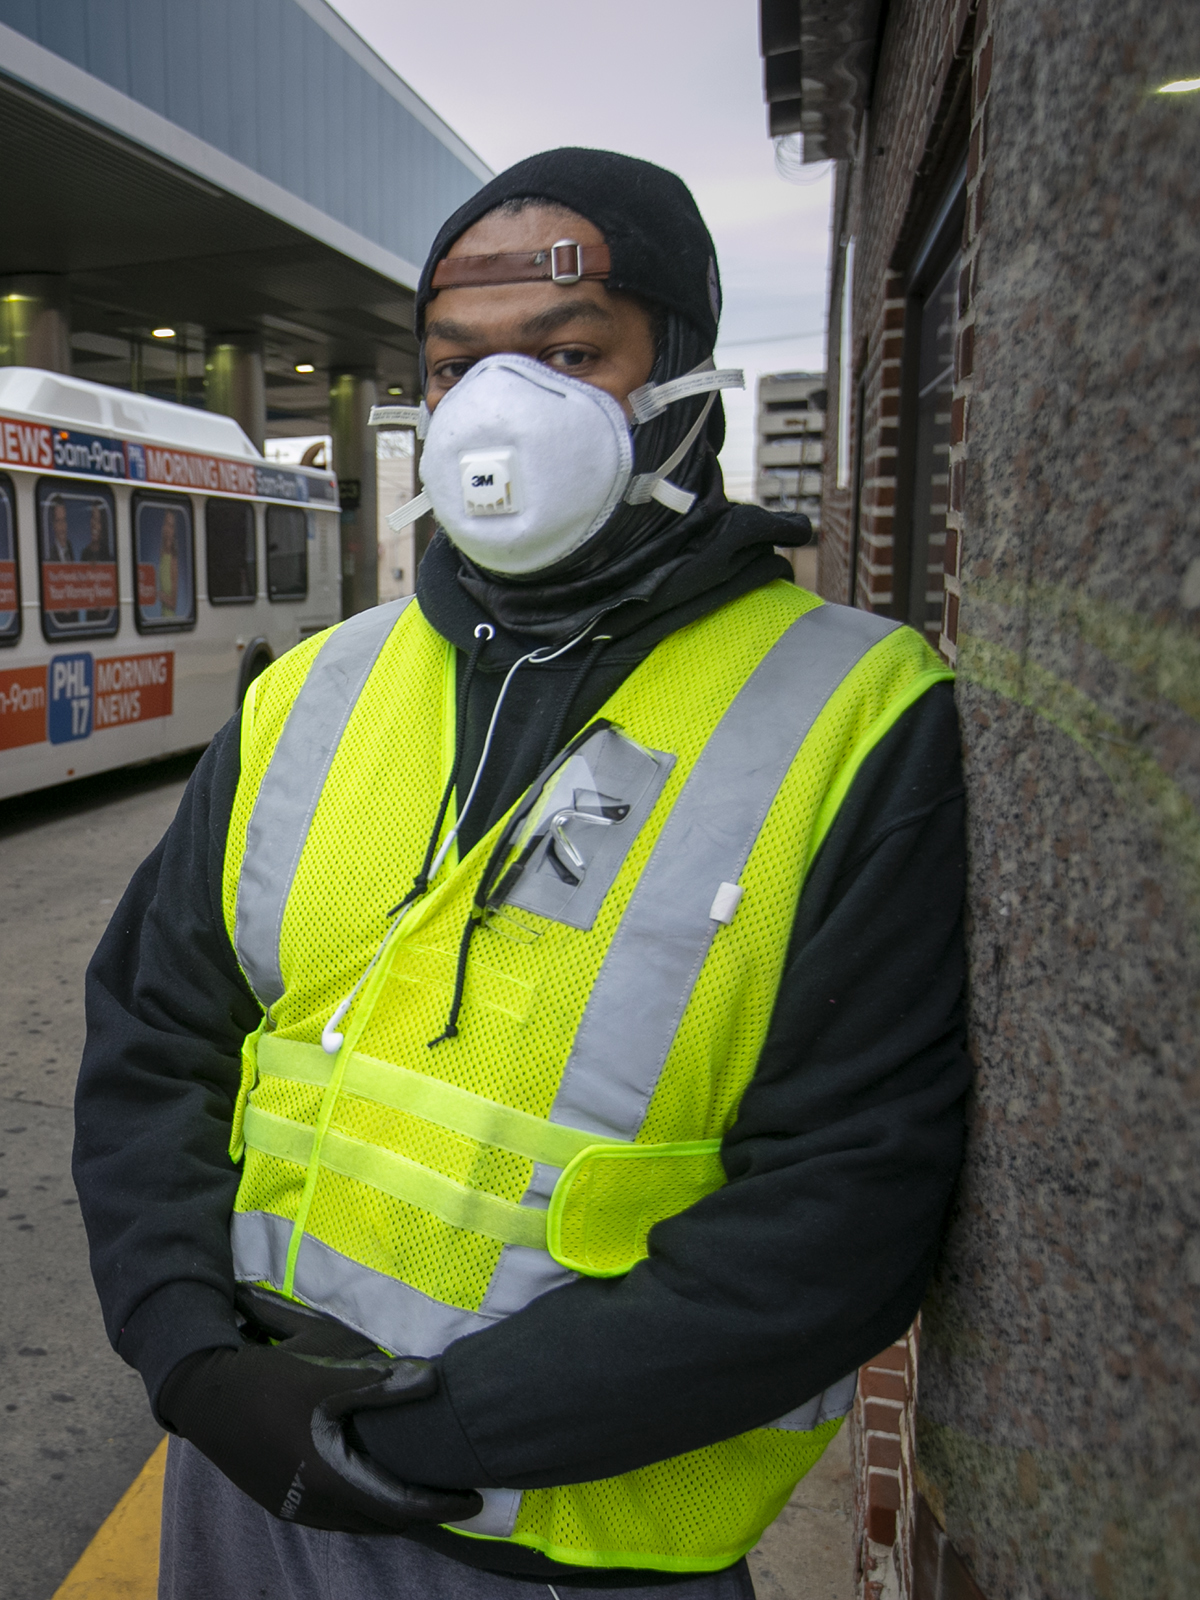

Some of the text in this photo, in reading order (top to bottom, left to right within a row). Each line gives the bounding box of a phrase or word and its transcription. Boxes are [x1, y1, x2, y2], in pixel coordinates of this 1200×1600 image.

[145, 448, 219, 490] MORNING
[219, 460, 257, 495] NEWS
[471, 474, 494, 488] 3M
[52, 659, 90, 701] PHL
[96, 656, 167, 694] MORNING
[70, 698, 90, 736] 17
[96, 690, 141, 725] NEWS
